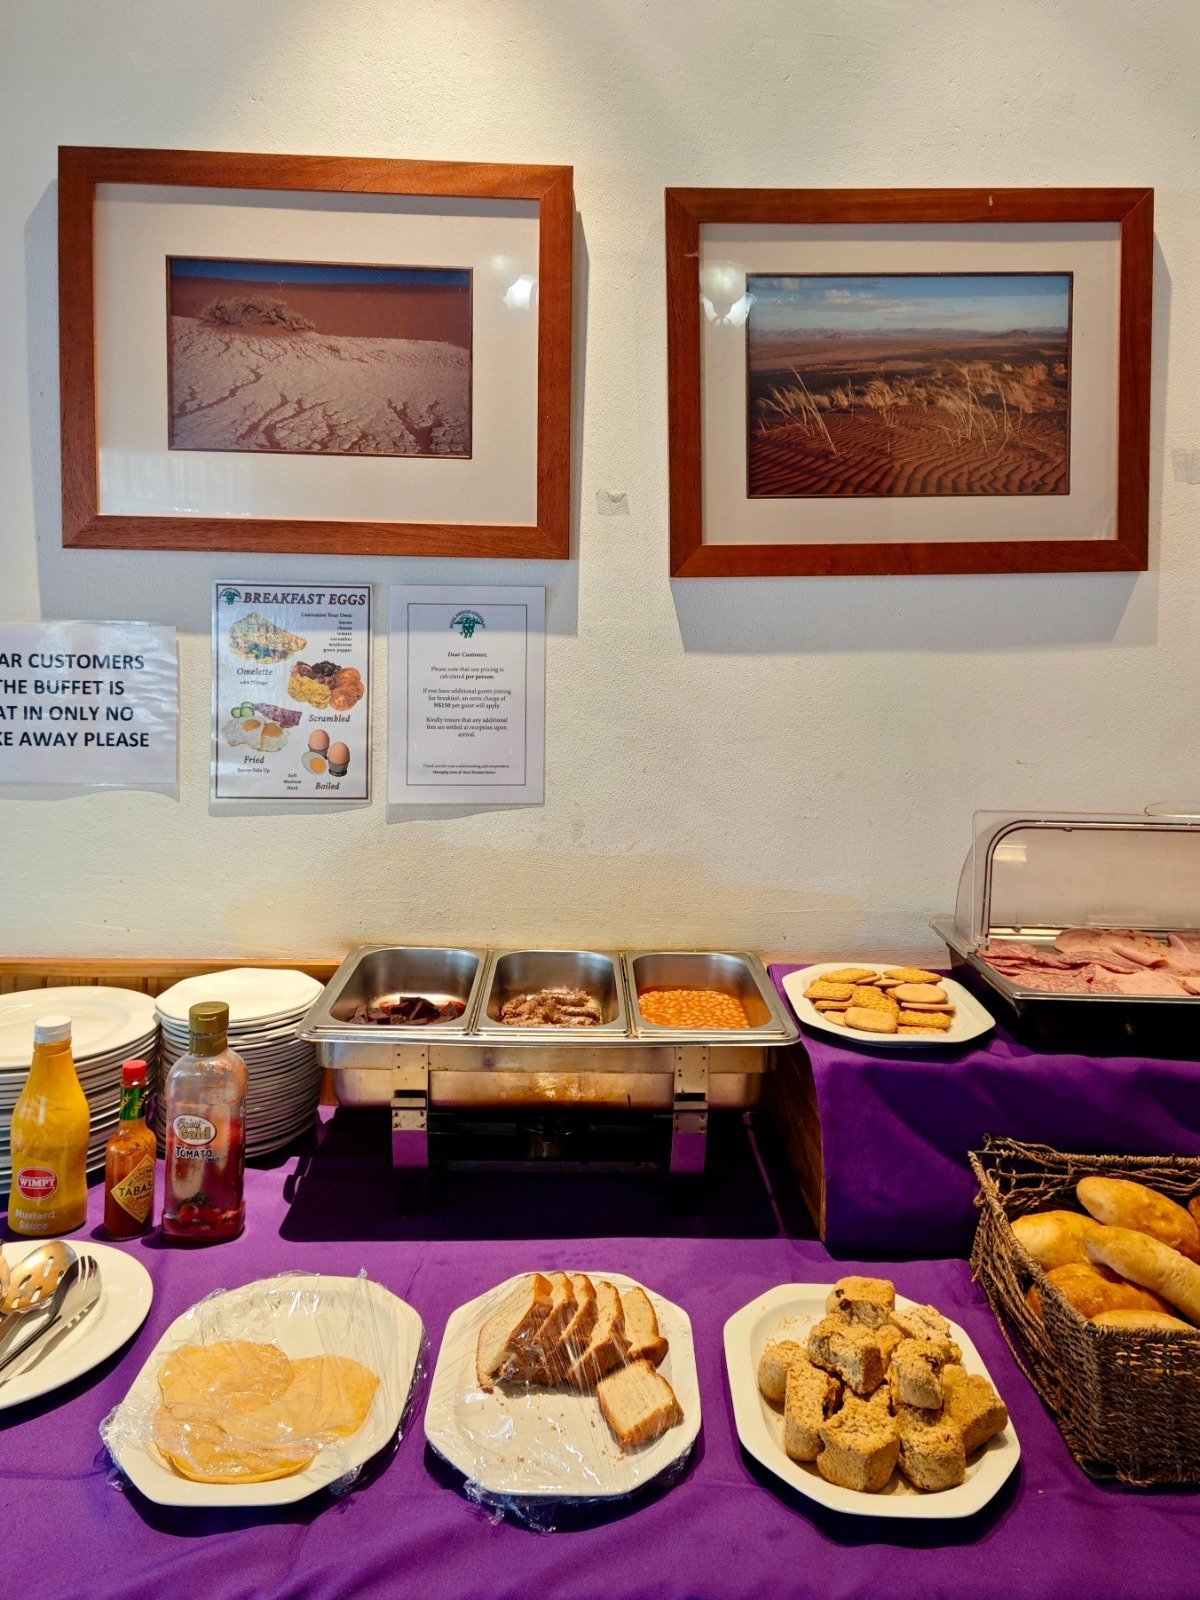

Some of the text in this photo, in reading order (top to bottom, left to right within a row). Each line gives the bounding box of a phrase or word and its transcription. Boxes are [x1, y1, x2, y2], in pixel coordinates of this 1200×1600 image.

[243, 592, 325, 605] BREAKFAST
[328, 594, 366, 606] EGGS
[28, 654, 145, 670] CUSTOMERS
[236, 667, 273, 676] Omelette
[34, 680, 103, 695] BUFFET
[110, 681, 124, 695] IS
[24, 706, 43, 720] IN
[49, 706, 100, 721] ONLY
[106, 706, 134, 721] NO
[308, 714, 350, 723] Scrambled
[0, 731, 149, 747] E AWAY PLEASE
[243, 756, 265, 764] Fried
[315, 782, 340, 790] Boiled
[178, 1126, 211, 1140] Gold
[175, 1146, 213, 1158] TOMATO
[19, 1177, 56, 1188] WIMPY
[15, 1209, 55, 1219] Mustard
[19, 1220, 48, 1230] Sauce
